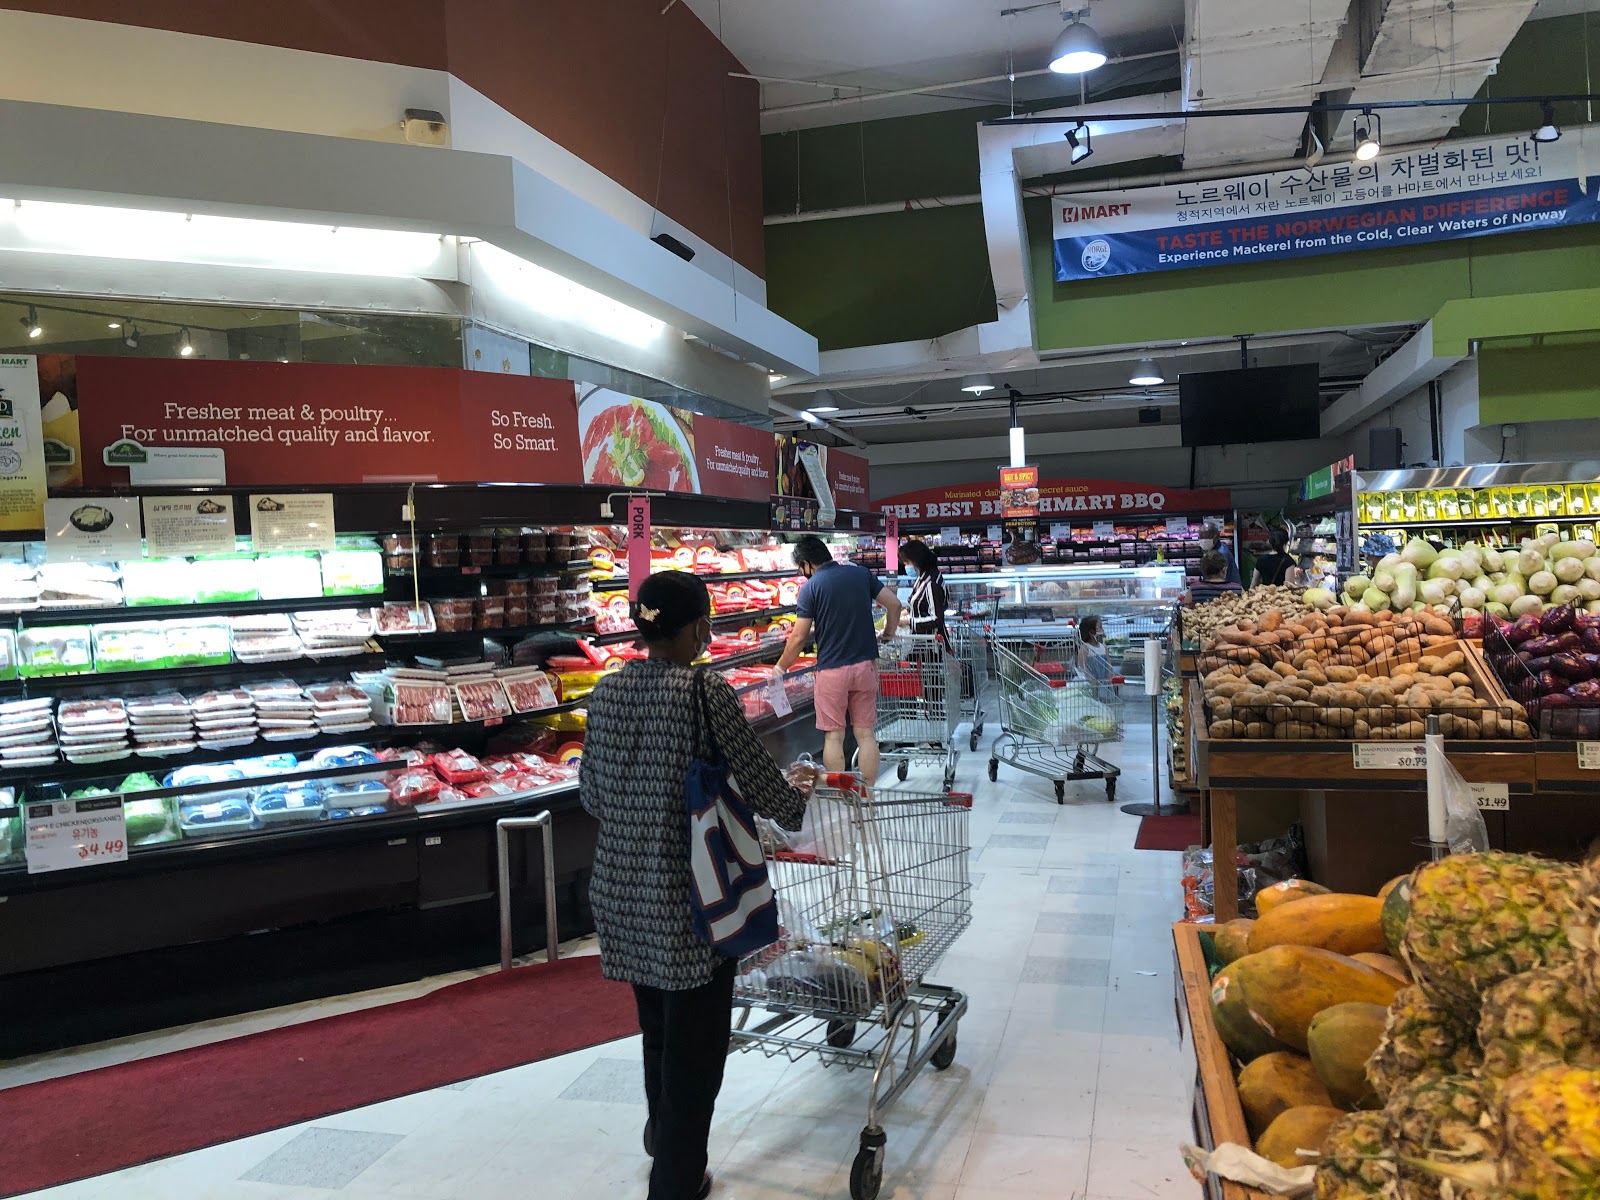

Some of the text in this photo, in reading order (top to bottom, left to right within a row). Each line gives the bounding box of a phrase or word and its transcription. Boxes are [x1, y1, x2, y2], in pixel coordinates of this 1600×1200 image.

[1175, 140, 1539, 206] 노르웨이 수산물의 차별화된 맛!
[1255, 200, 1280, 213] 자란
[1285, 192, 1336, 209] 노르웨이
[1341, 185, 1394, 202] 고등어를
[1398, 175, 1463, 194] H마트에서
[1468, 166, 1542, 187] 만나보세요!
[1081, 203, 1132, 221] MART
[1156, 188, 1568, 251] TASTE THE NORWEGIAN DIFFERENCE
[1158, 209, 1567, 264] Experience Mackerel from the Cold, Clear Waters of Norway
[1, 358, 29, 366] MART
[164, 402, 397, 425] Fresher meat & poultry...
[491, 410, 555, 430] So Fresh.
[121, 424, 435, 446] For unmatched quality and flavor.
[493, 433, 559, 451] So Smart.
[944, 489, 982, 499] Marinated
[1039, 486, 1064, 494] secret
[1064, 485, 1089, 493] sauce
[881, 503, 921, 519] THE
[925, 501, 974, 518] BEST
[1039, 494, 1116, 512] HMART
[1119, 492, 1166, 510] BBQ
[633, 506, 644, 539] PORK
[1398, 757, 1427, 767] $0.79
[1476, 796, 1507, 807] $1.49
[79, 839, 124, 859] $4.49
